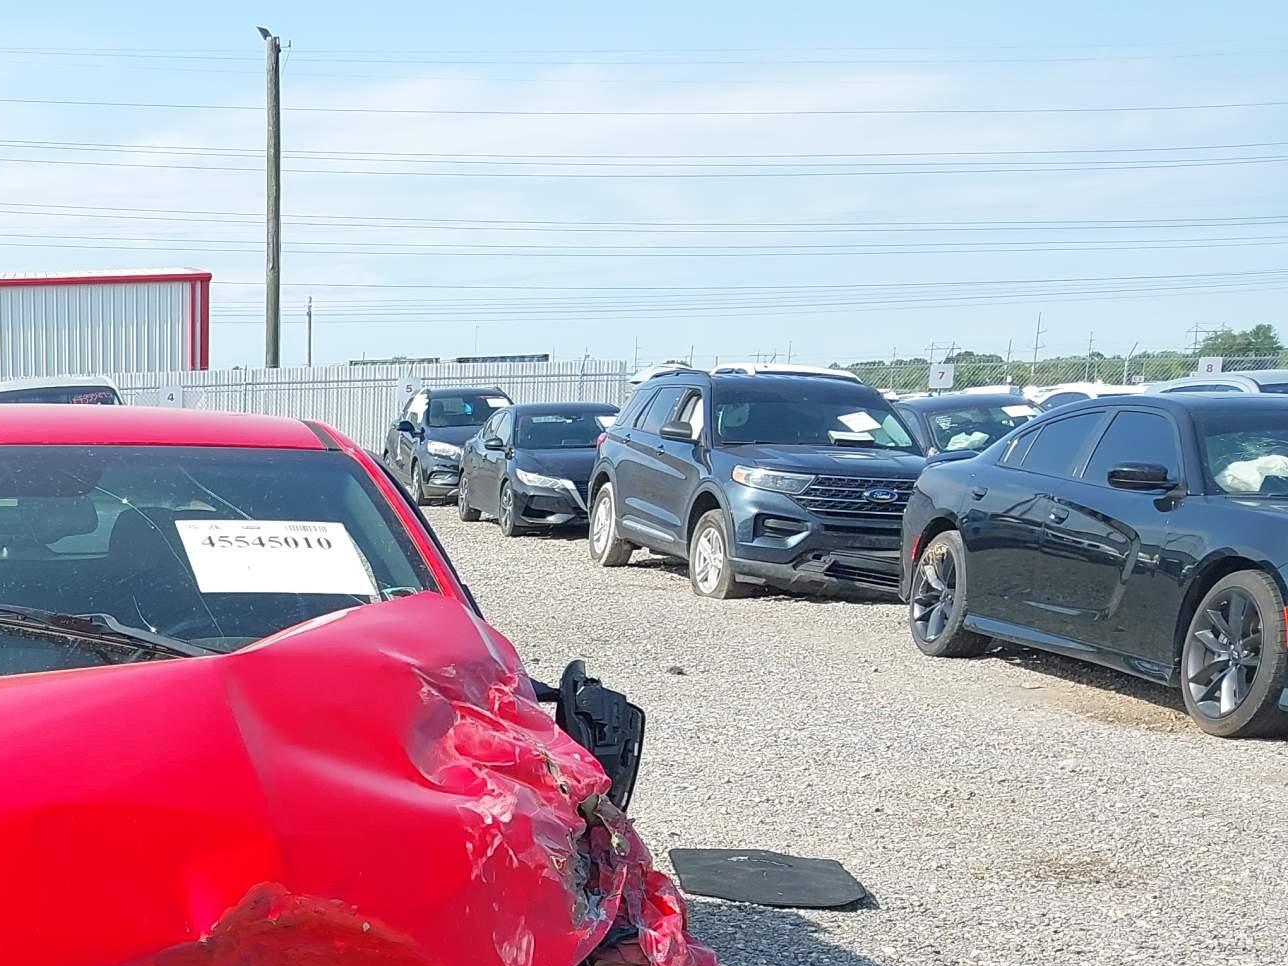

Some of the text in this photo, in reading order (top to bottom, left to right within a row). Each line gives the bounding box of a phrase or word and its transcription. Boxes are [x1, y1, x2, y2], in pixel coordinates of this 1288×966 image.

[1206, 363, 1213, 373] 8
[937, 371, 945, 380] 7
[405, 384, 413, 393] 5
[167, 392, 175, 401] 4
[201, 535, 333, 550] 45545010
